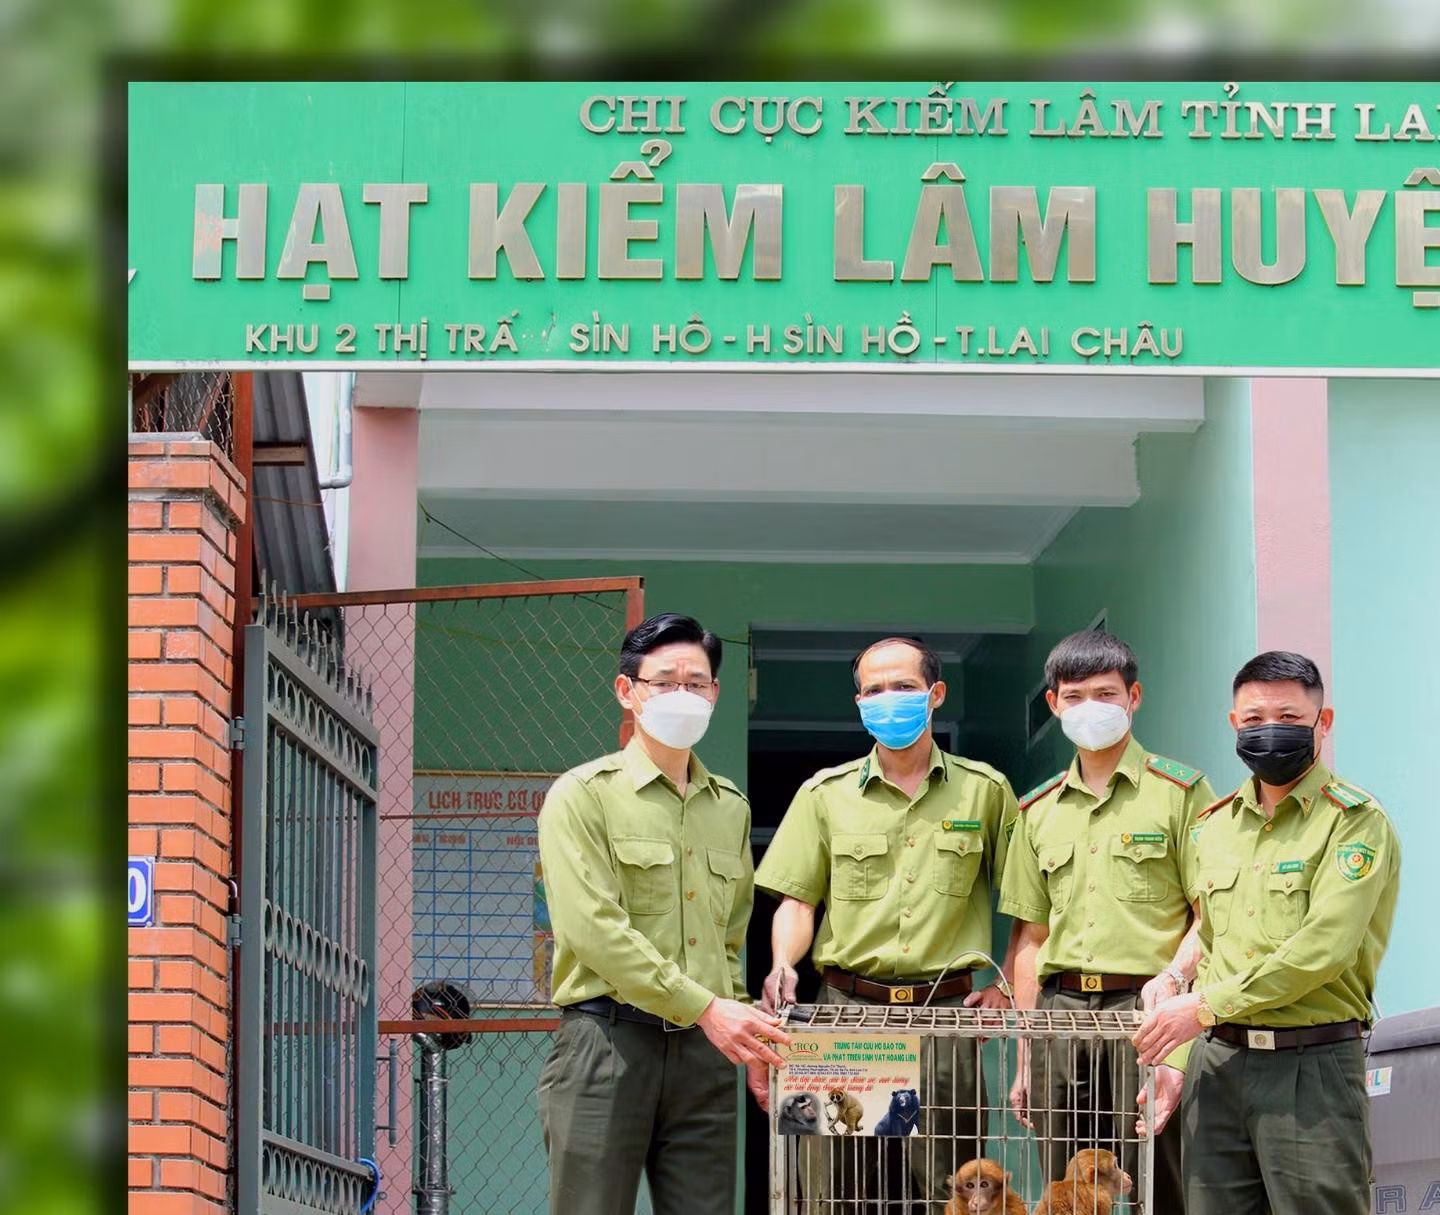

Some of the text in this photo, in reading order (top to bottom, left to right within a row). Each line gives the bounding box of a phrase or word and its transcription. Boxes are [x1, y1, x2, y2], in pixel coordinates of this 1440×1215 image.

[579, 95, 687, 134] CHI
[709, 97, 824, 144] CỤC
[1029, 87, 1163, 140] LÂM
[1182, 81, 1336, 142] TỈNH
[192, 183, 428, 300] HẠT
[468, 140, 783, 282] KIỂM
[834, 162, 1097, 283] LÂM
[246, 324, 319, 353] KHU
[336, 325, 356, 352] 2
[375, 317, 428, 360] THỊ
[569, 311, 629, 353] SÌN
[862, 311, 921, 354] HỒ
[1071, 320, 1184, 358] CHÂU
